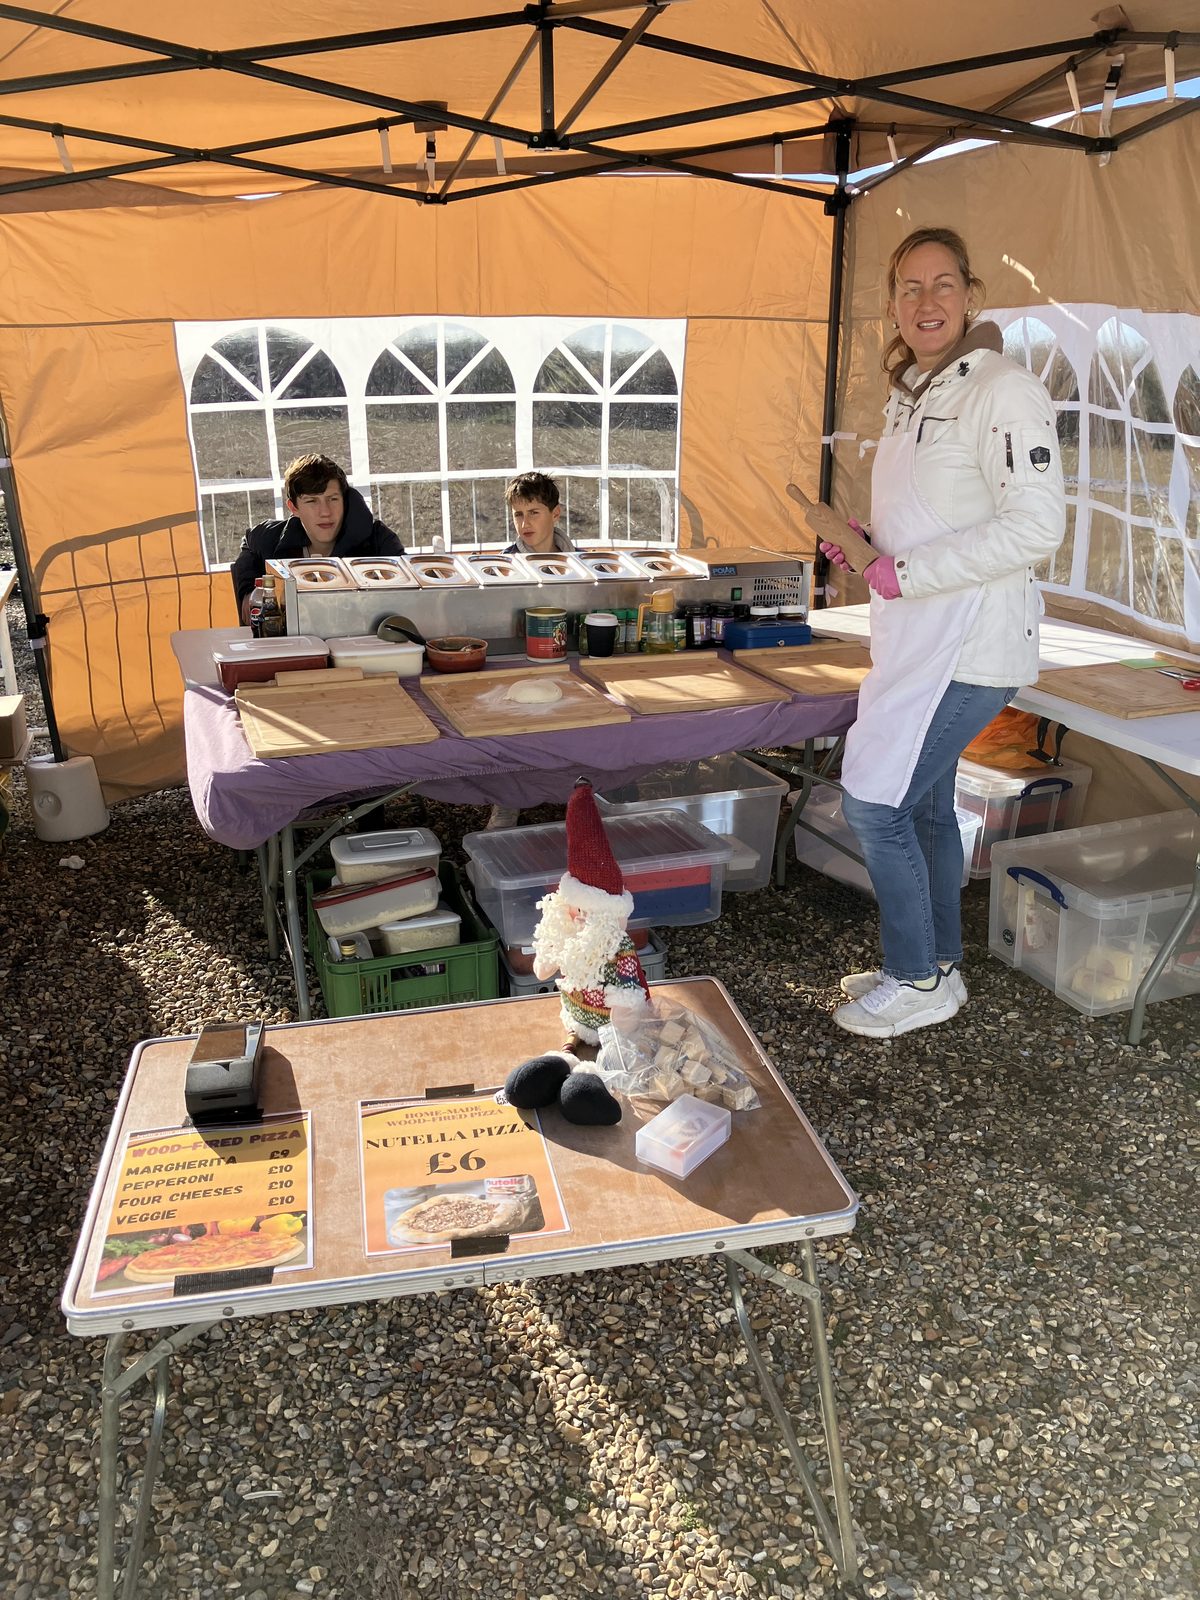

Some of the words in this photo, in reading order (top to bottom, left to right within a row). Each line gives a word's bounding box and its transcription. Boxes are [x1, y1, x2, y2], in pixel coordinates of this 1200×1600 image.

[713, 567, 736, 575] POLAR
[386, 1114, 469, 1127] WOOD-FIRED
[470, 1108, 504, 1118] PIZZA
[405, 1105, 482, 1119] HOME-MADE
[132, 1137, 243, 1157] WOOD-FIRED
[250, 1129, 301, 1144] PIZZA
[366, 1130, 468, 1149] NUTELLA
[472, 1122, 534, 1138] PIZZA
[126, 1156, 237, 1176] MARGHERITA
[269, 1149, 290, 1160] £9
[426, 1149, 486, 1176] £6
[122, 1173, 214, 1191] PEPPERONI
[267, 1164, 293, 1175] £10
[118, 1195, 162, 1208] FOUR
[169, 1186, 243, 1202] CHEESES
[267, 1179, 293, 1190] £10
[116, 1209, 178, 1225] VEGGIE
[267, 1195, 295, 1207] £10
